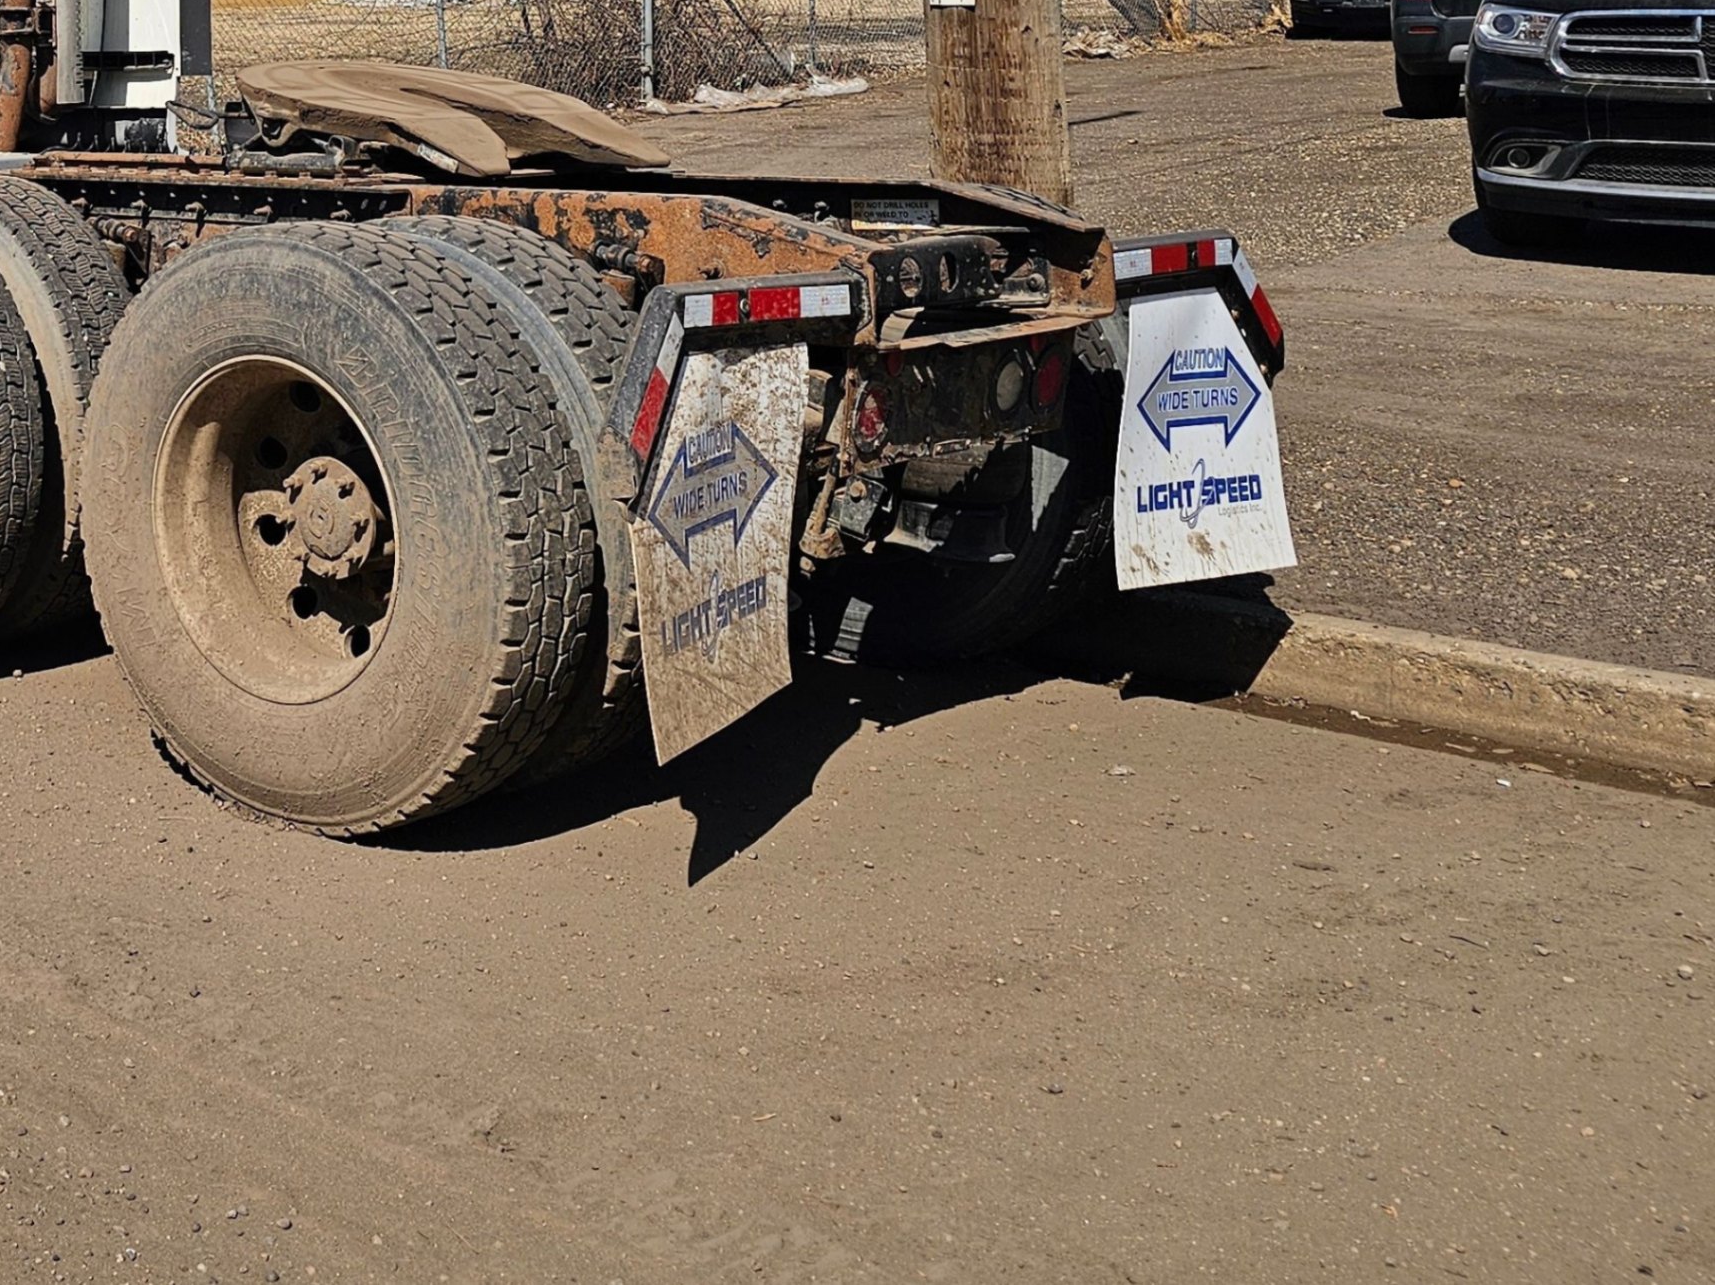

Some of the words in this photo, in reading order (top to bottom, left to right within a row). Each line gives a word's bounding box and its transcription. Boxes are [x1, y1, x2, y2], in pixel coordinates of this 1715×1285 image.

[866, 201, 882, 209] NOT
[883, 201, 905, 209] DRILL
[907, 201, 929, 209] HOLES
[897, 210, 909, 218] TO
[1175, 348, 1224, 371] CAUTION
[1157, 391, 1189, 411] WIDE
[1193, 387, 1238, 408] TURNS
[688, 422, 732, 464] CAUTION
[673, 485, 704, 519] WIDE
[706, 471, 748, 507] TURNS
[1137, 480, 1195, 513] LIGHT
[1201, 474, 1262, 506] SPEED
[661, 598, 711, 655] LIGHT
[717, 575, 767, 629] SPEED
